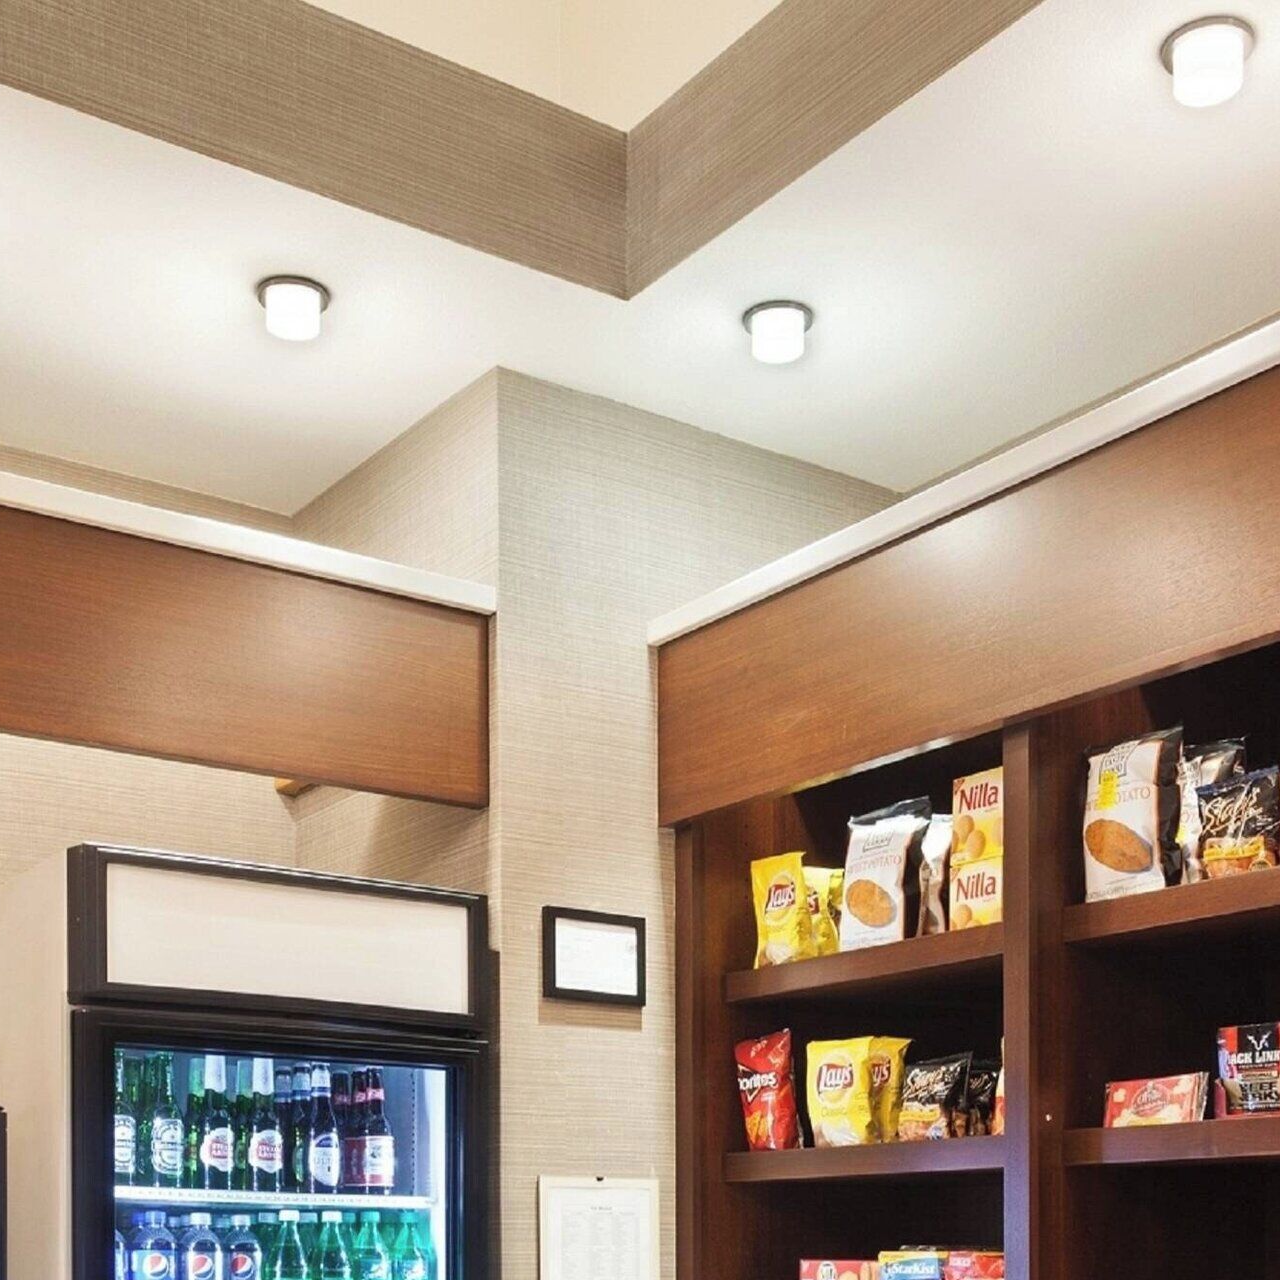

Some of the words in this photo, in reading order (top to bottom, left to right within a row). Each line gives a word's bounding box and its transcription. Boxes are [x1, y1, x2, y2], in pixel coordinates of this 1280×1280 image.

[959, 782, 999, 812] Nilla
[956, 875, 996, 902] Nilla
[820, 1063, 854, 1090] Lay's
